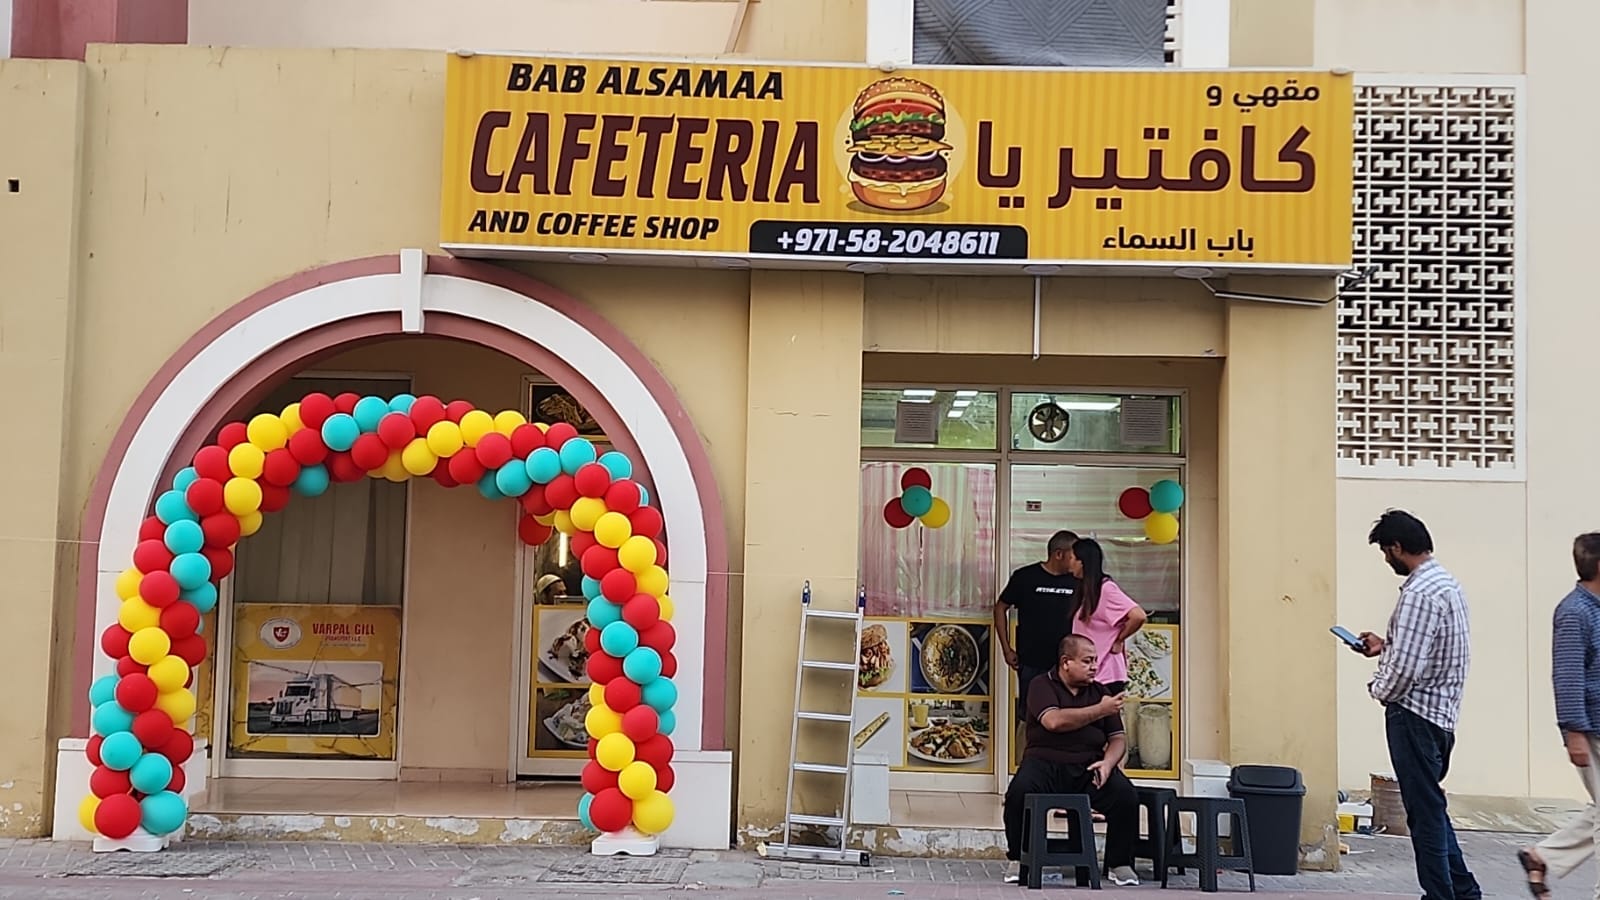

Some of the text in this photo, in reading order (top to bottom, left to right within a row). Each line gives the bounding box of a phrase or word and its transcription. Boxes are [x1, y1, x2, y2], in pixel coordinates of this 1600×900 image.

[506, 63, 784, 101] BAB ALSAMAA
[1206, 85, 1222, 107] و
[470, 110, 820, 204] CAFETERIA
[467, 210, 720, 241] AND COFFEE SHOP
[777, 228, 1000, 255] +971-58-2048611
[1102, 226, 1254, 258] باب السماء
[312, 623, 375, 635] VARPAL GILL
